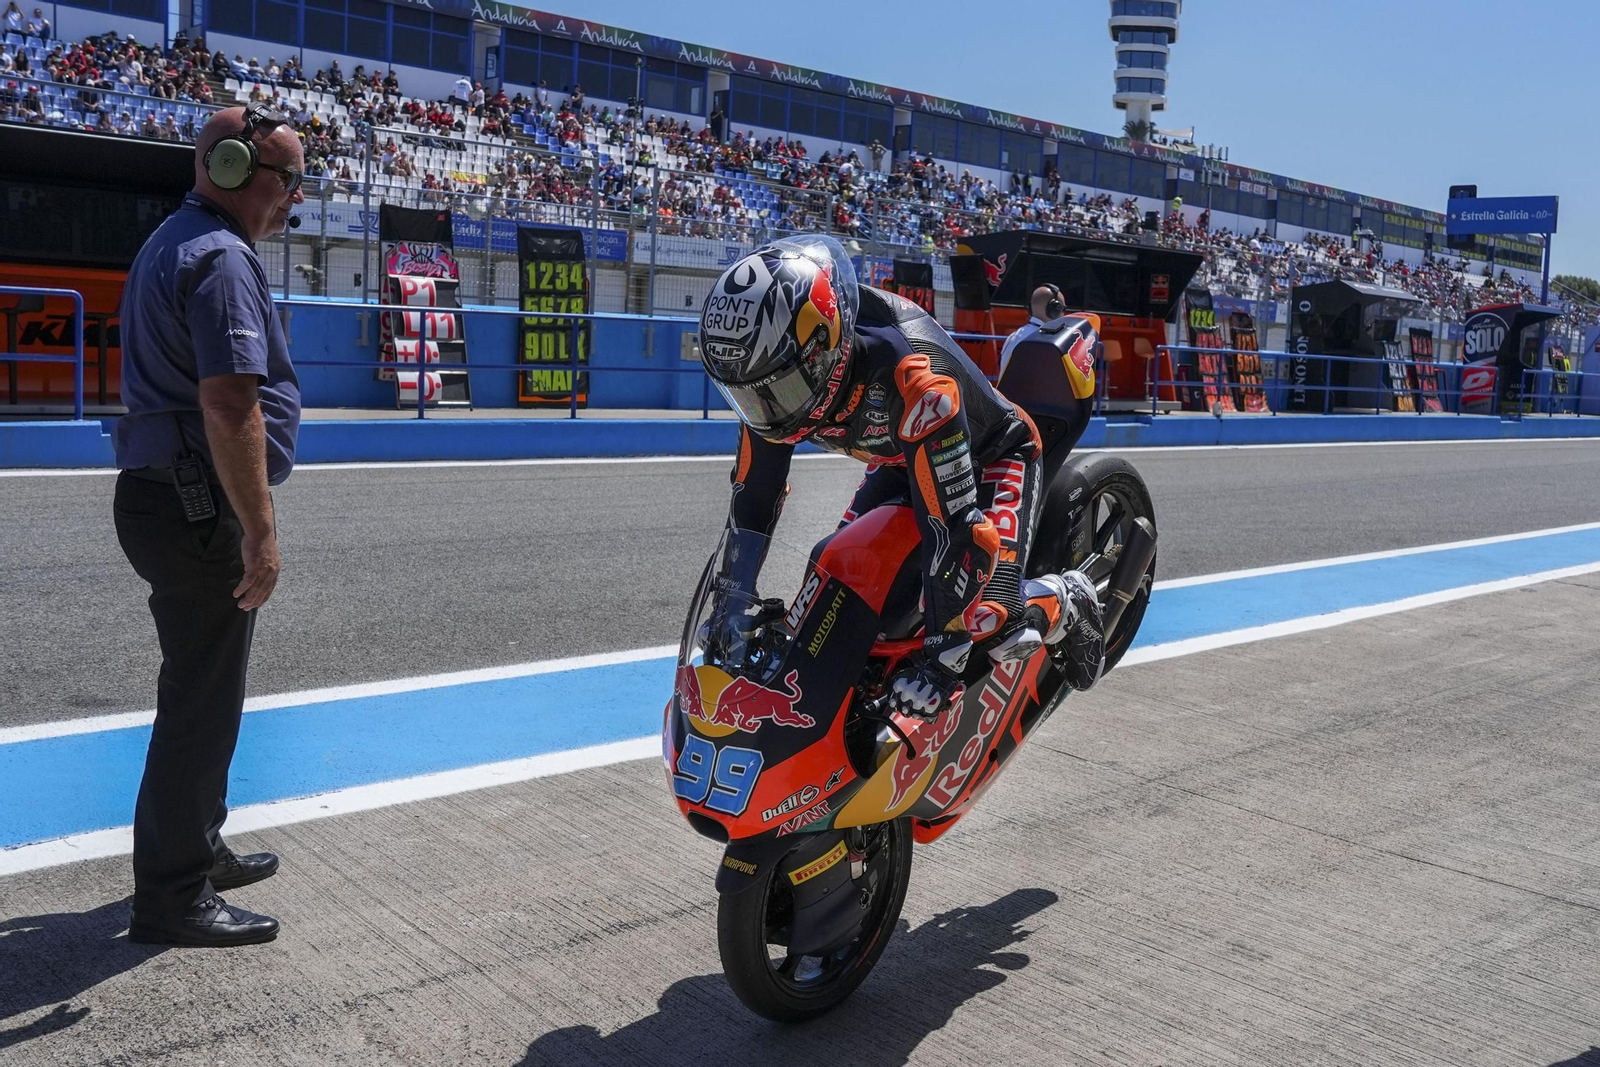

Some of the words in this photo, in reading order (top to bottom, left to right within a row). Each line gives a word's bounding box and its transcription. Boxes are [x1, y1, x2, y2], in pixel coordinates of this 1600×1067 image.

[471, 0, 541, 31] Andalucía
[581, 23, 643, 51] Andalucía
[679, 43, 736, 71] Andalucía
[771, 64, 822, 89] Andalucía
[848, 80, 894, 104] Andalucía
[920, 95, 963, 118] Andalucía
[987, 110, 1026, 132] Andalucía
[1461, 211, 1495, 221] Estrella
[1496, 210, 1529, 220] Galicia
[526, 261, 583, 290] 1234
[401, 277, 435, 307] P1
[709, 295, 754, 315] PONT
[524, 295, 584, 325] 5678
[706, 313, 749, 332] GRUP
[1190, 309, 1214, 327] 1234
[708, 344, 742, 357] HJC
[1465, 327, 1505, 354] SOLO
[742, 374, 777, 390] WINGS
[809, 381, 840, 420] Red
[831, 337, 852, 380] Bull
[848, 384, 866, 413] KTM
[868, 411, 888, 419] HJC
[981, 459, 1025, 542] Bull
[786, 571, 820, 630] WRS
[807, 588, 846, 656] MOTOBATT
[924, 683, 1006, 809] Red
[673, 733, 765, 817] 99
[776, 799, 831, 838] AVANT
[794, 846, 844, 881] PIRELLI
